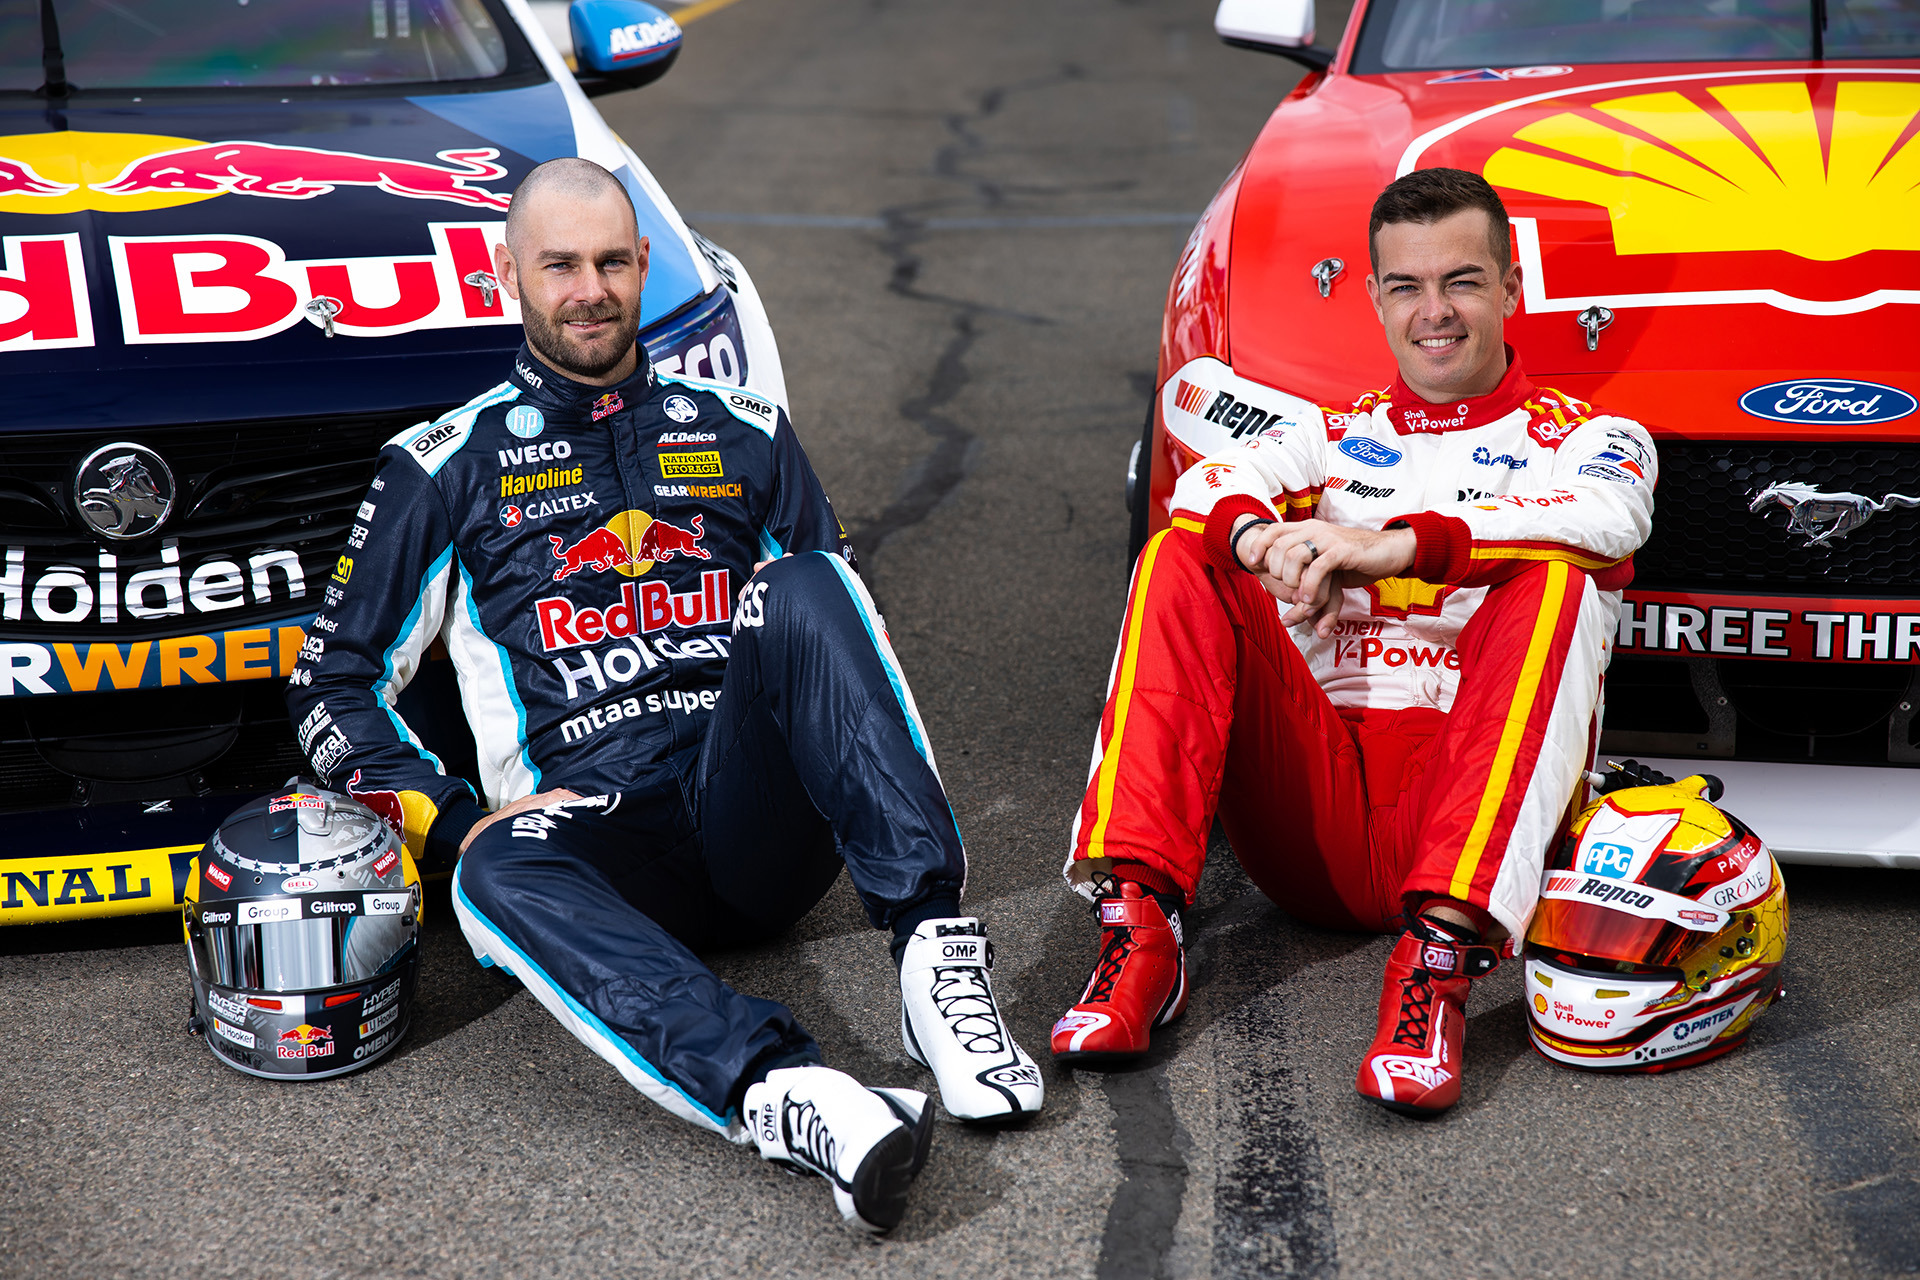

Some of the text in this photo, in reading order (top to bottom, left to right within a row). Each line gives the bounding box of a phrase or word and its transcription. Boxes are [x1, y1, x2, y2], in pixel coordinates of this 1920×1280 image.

[108, 220, 523, 345] Bul
[591, 399, 625, 422] Red Bull
[730, 395, 772, 415] OMP
[1774, 384, 1882, 416] Ford
[513, 407, 538, 438] hp
[1204, 391, 1283, 440] Rep
[1404, 410, 1426, 421] Shell
[1406, 414, 1467, 432] V-Power
[415, 425, 456, 452] OMP
[658, 432, 717, 444] ACDelco
[498, 440, 572, 468] IVECO
[662, 454, 719, 464] NATIONAL
[1350, 441, 1392, 463] Ford
[500, 465, 584, 498] Havoline
[667, 463, 718, 474] STORAGE
[653, 483, 743, 498] GEARWRENCH
[1345, 480, 1396, 499] Repco
[525, 492, 600, 520] CALTEX
[535, 569, 731, 652] Red Bull
[1334, 620, 1384, 636] Shell
[1619, 601, 1790, 656] HREE
[1334, 637, 1461, 670] V-Powe
[560, 697, 643, 743] mtaa
[268, 800, 326, 814] Red Bull
[374, 852, 396, 871] WARD
[1586, 844, 1632, 874] PPG
[1716, 844, 1756, 873] PAYCE
[0, 864, 151, 909] NAL
[208, 864, 231, 886] WARD
[287, 880, 315, 888] BELL
[1577, 878, 1655, 909] Repco
[1713, 871, 1766, 907] GROVE
[202, 898, 400, 924] Giltrap Group Giltrap Group
[942, 945, 977, 957] OMP
[209, 990, 248, 1016] HYPER
[363, 978, 401, 1009] HYPER
[1553, 1001, 1574, 1012] Shell
[223, 1010, 246, 1024] DRIVE
[1554, 1010, 1610, 1029] V-Power
[1690, 1006, 1736, 1033] PIRTEK
[227, 1028, 253, 1044] Hooker
[353, 1031, 390, 1060] OMEN
[219, 1041, 252, 1064] OMEN
[277, 1041, 335, 1059] Red Bull
[763, 1103, 775, 1142] OMP
